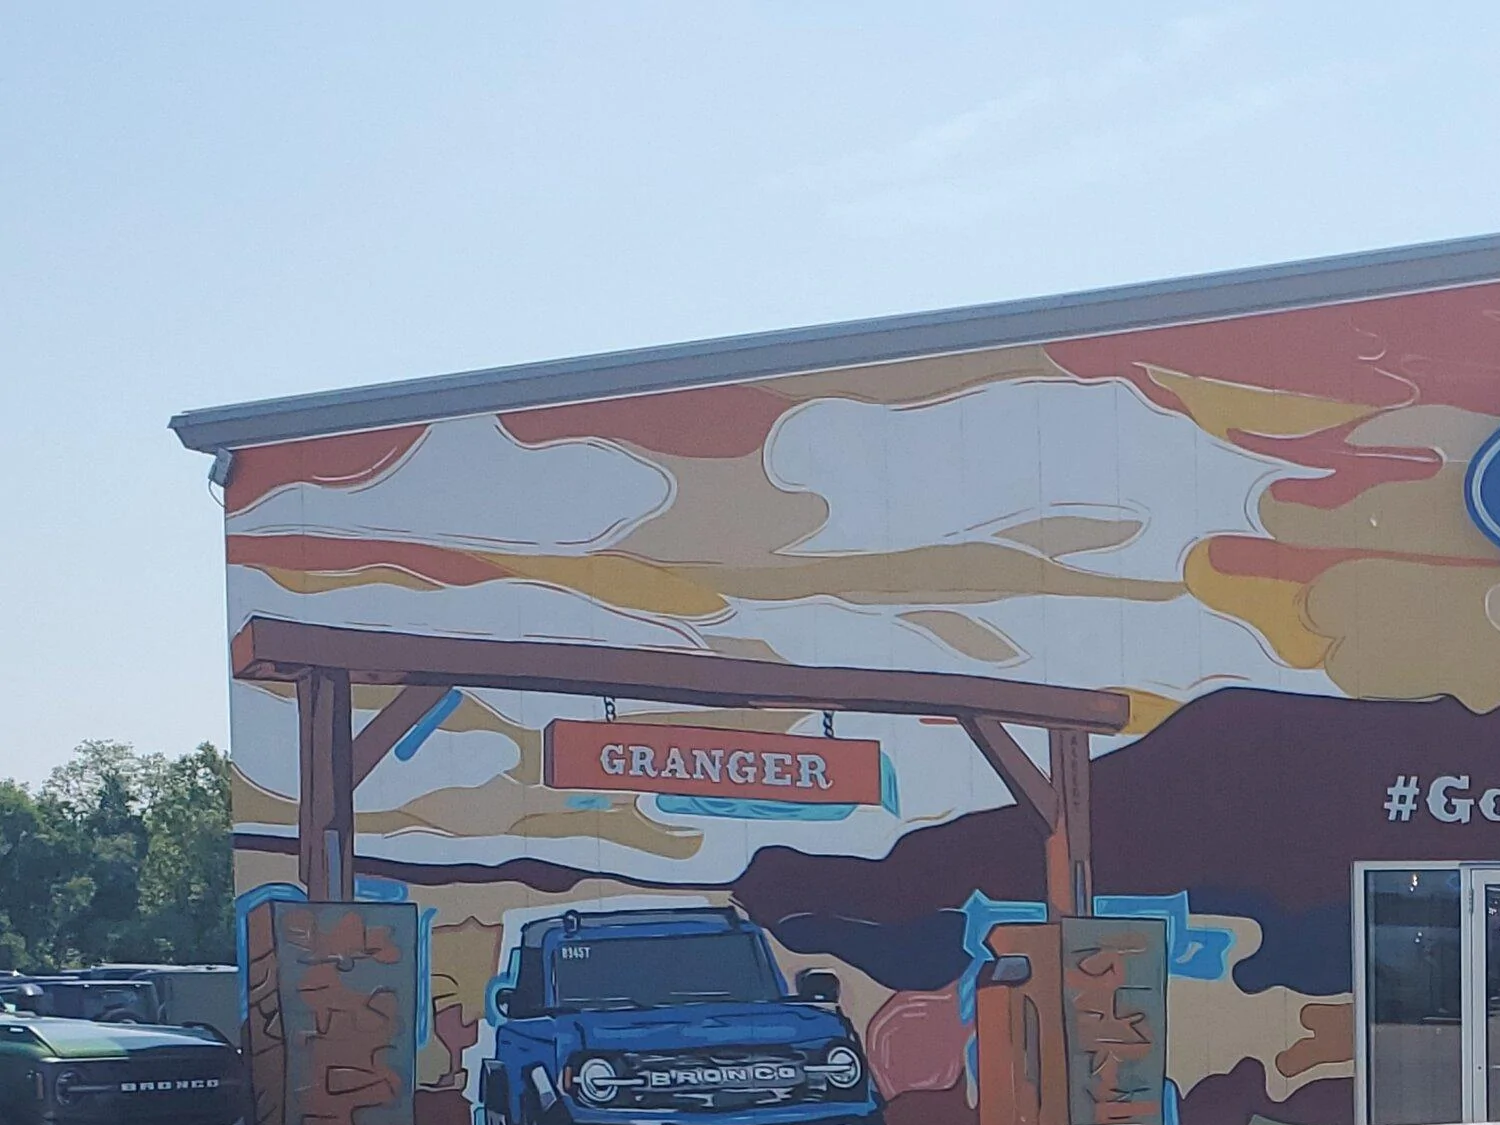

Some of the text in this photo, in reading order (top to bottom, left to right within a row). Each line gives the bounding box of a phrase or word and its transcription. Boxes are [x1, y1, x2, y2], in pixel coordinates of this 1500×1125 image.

[600, 744, 833, 789] GRANGER
[121, 1080, 219, 1091] BRONCO
[651, 1067, 796, 1086] BRONCO
